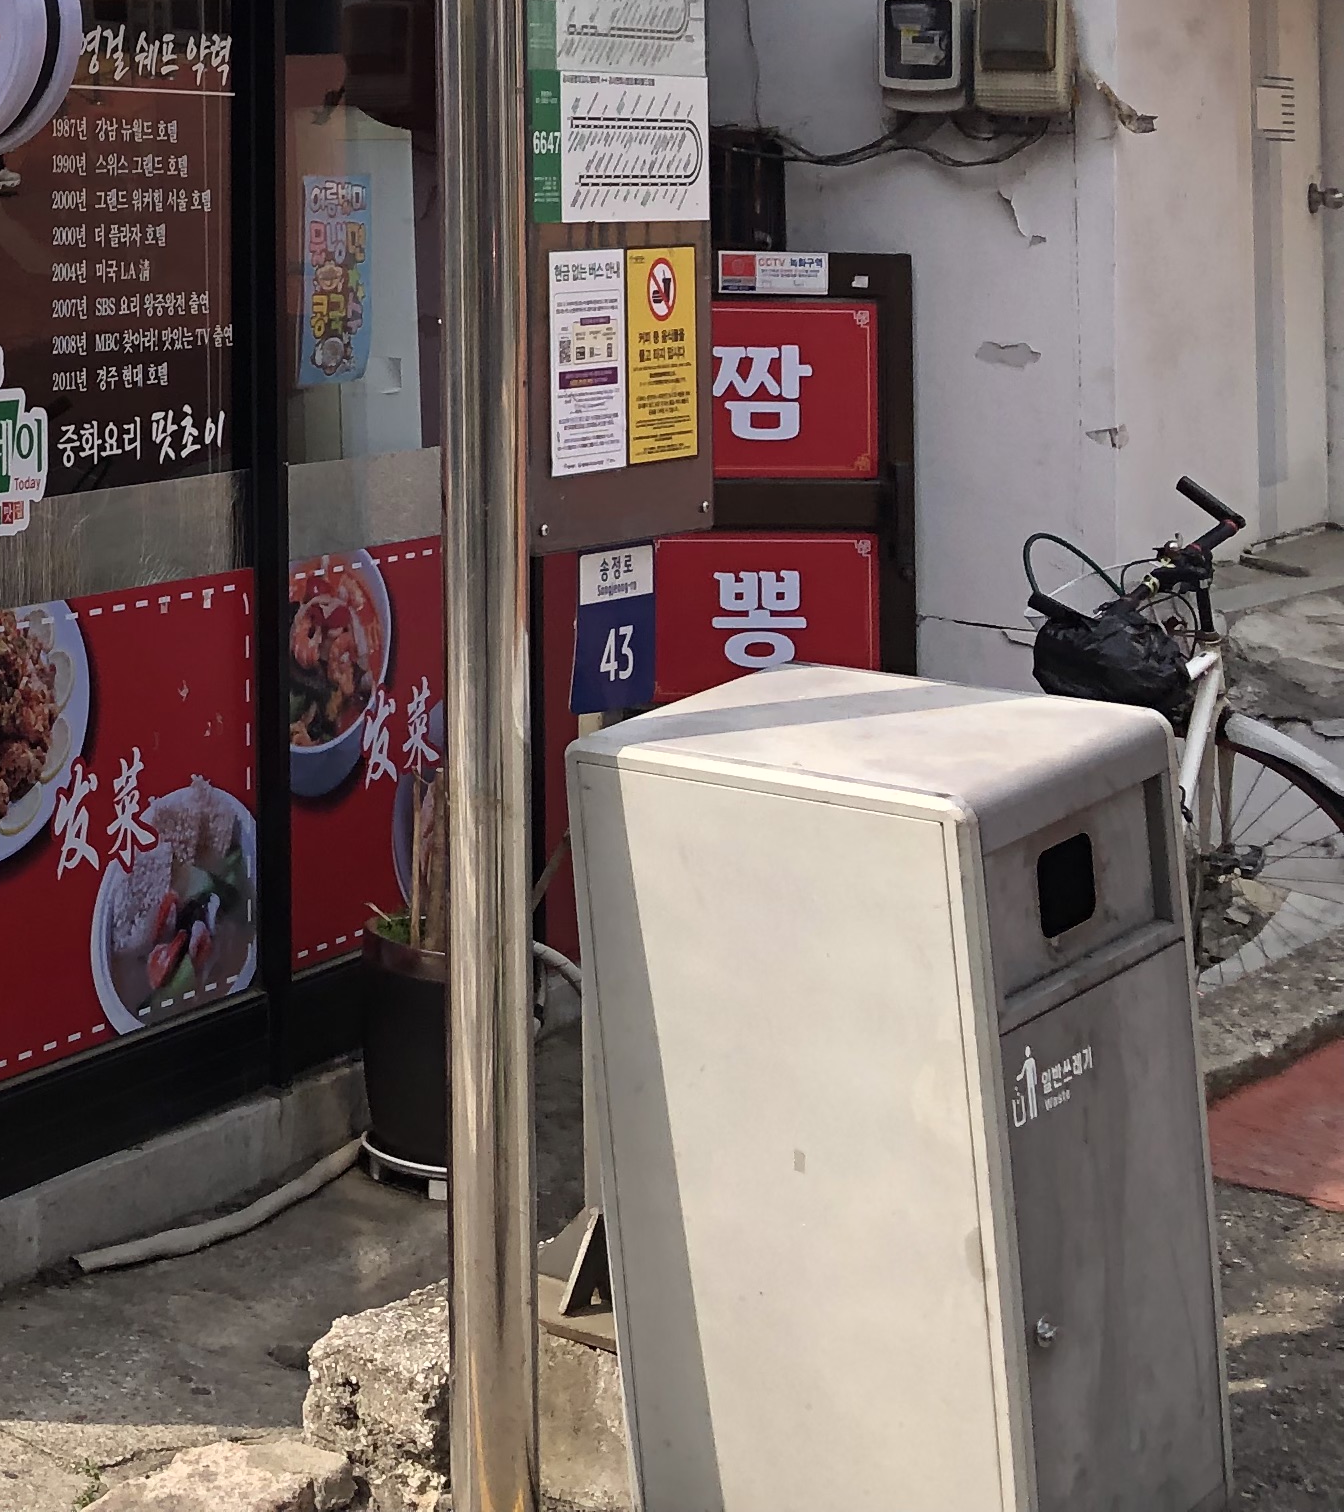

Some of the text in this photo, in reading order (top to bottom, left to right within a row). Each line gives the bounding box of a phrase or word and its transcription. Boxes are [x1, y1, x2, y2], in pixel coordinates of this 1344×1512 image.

[135, 31, 179, 76] 쉐프
[186, 33, 232, 86] 약력
[52, 117, 178, 143] 1987년 강남 뉴월드 호텔
[533, 131, 561, 154] 6647
[52, 152, 188, 178] 1990년 스위스 그랜드 호텔
[52, 188, 212, 212] 2000년 그랜드 워커힐 서울 호텔
[52, 224, 166, 248] 2000년 더 플라자 호텔
[52, 260, 87, 284] 2004년
[96, 259, 118, 283] 미국
[121, 261, 136, 280] LA
[554, 261, 620, 282] 현금 없는 버스 안내
[758, 257, 786, 267] CCTV
[52, 291, 209, 320] 2007년 SBS 요리 왕중왕전 출연
[52, 324, 234, 355] 2008년 MBC 찾아라! 맛있는 TV 출연
[52, 362, 168, 391] 2011년 경주 현대 호텔
[57, 404, 225, 468] 중화요리 팟초이
[14, 476, 41, 491] Today
[599, 554, 633, 582] 송정로
[712, 570, 808, 669] 뽕
[600, 625, 634, 682] 43
[1041, 1045, 1094, 1095] 일반쓰레기
